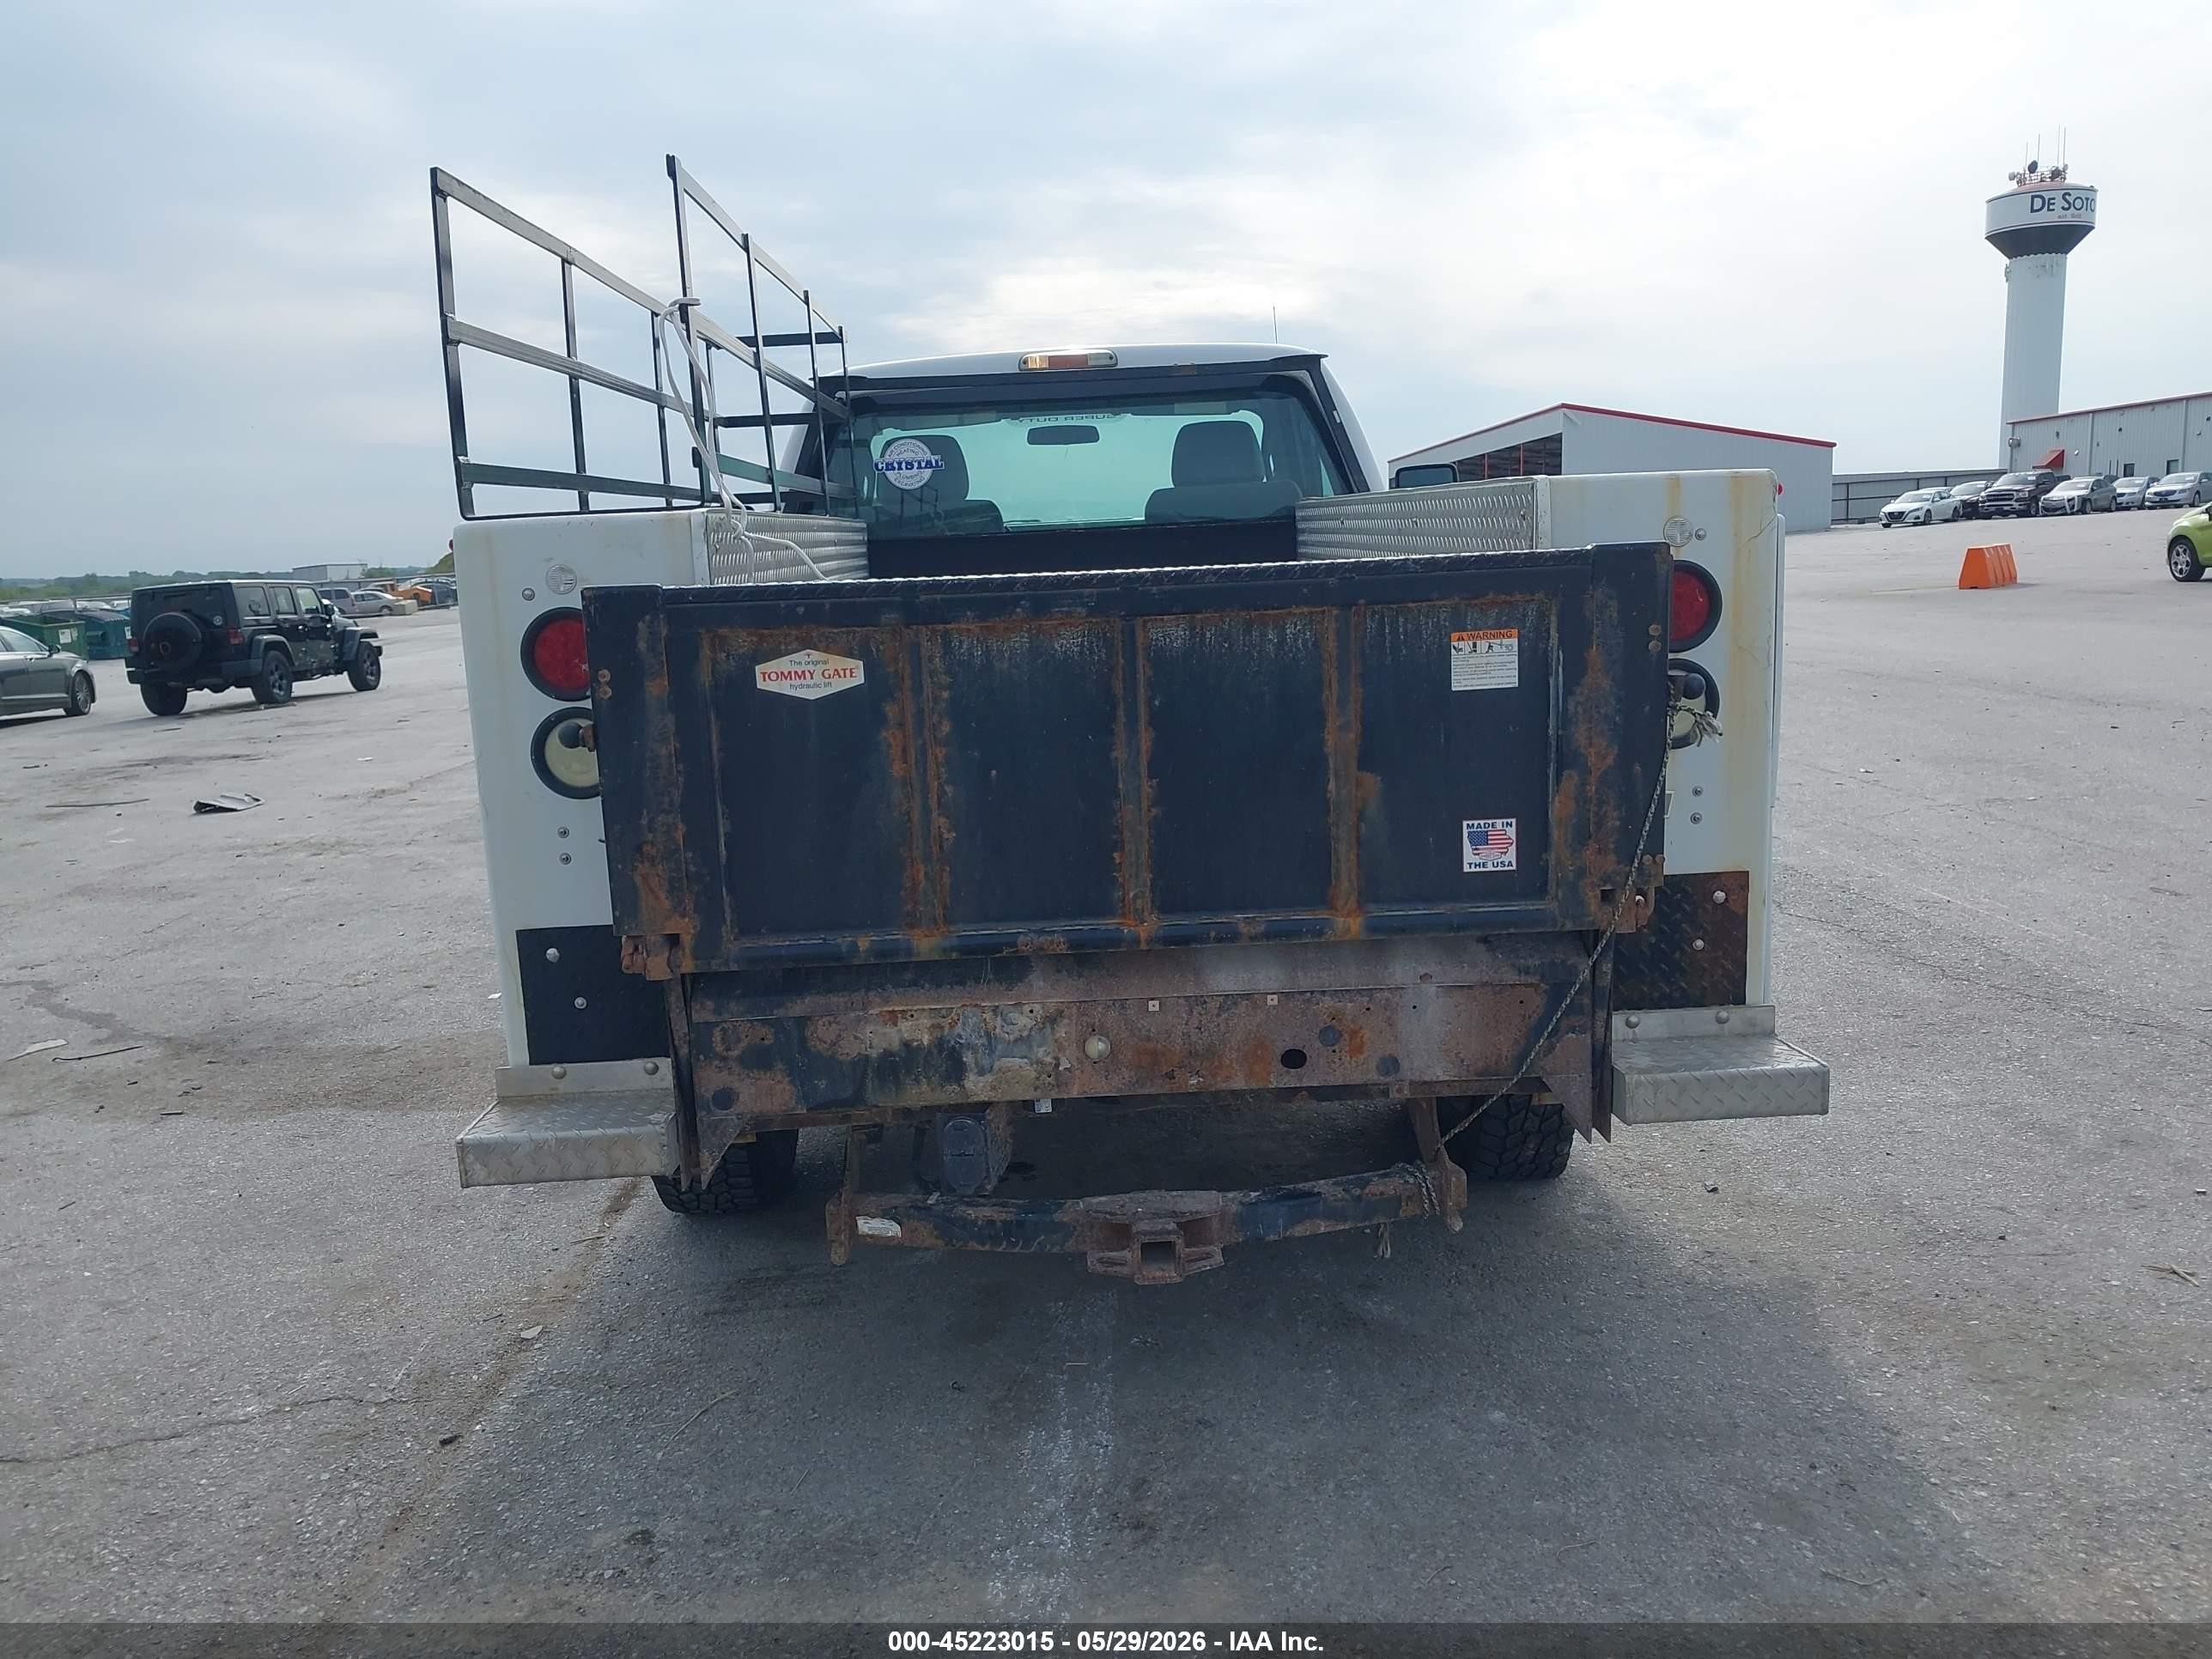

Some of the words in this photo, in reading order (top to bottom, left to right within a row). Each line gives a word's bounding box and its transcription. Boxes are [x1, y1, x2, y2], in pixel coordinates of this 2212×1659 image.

[896, 447, 920, 456] HEATING
[874, 455, 944, 471] CRYSTAL
[1467, 630, 1513, 640] WARNING
[760, 670, 817, 682] TOMMY
[821, 667, 858, 679] GATE
[790, 682, 822, 690] hydraulic
[1466, 822, 1498, 830] MADE
[1467, 861, 1488, 870] THE
